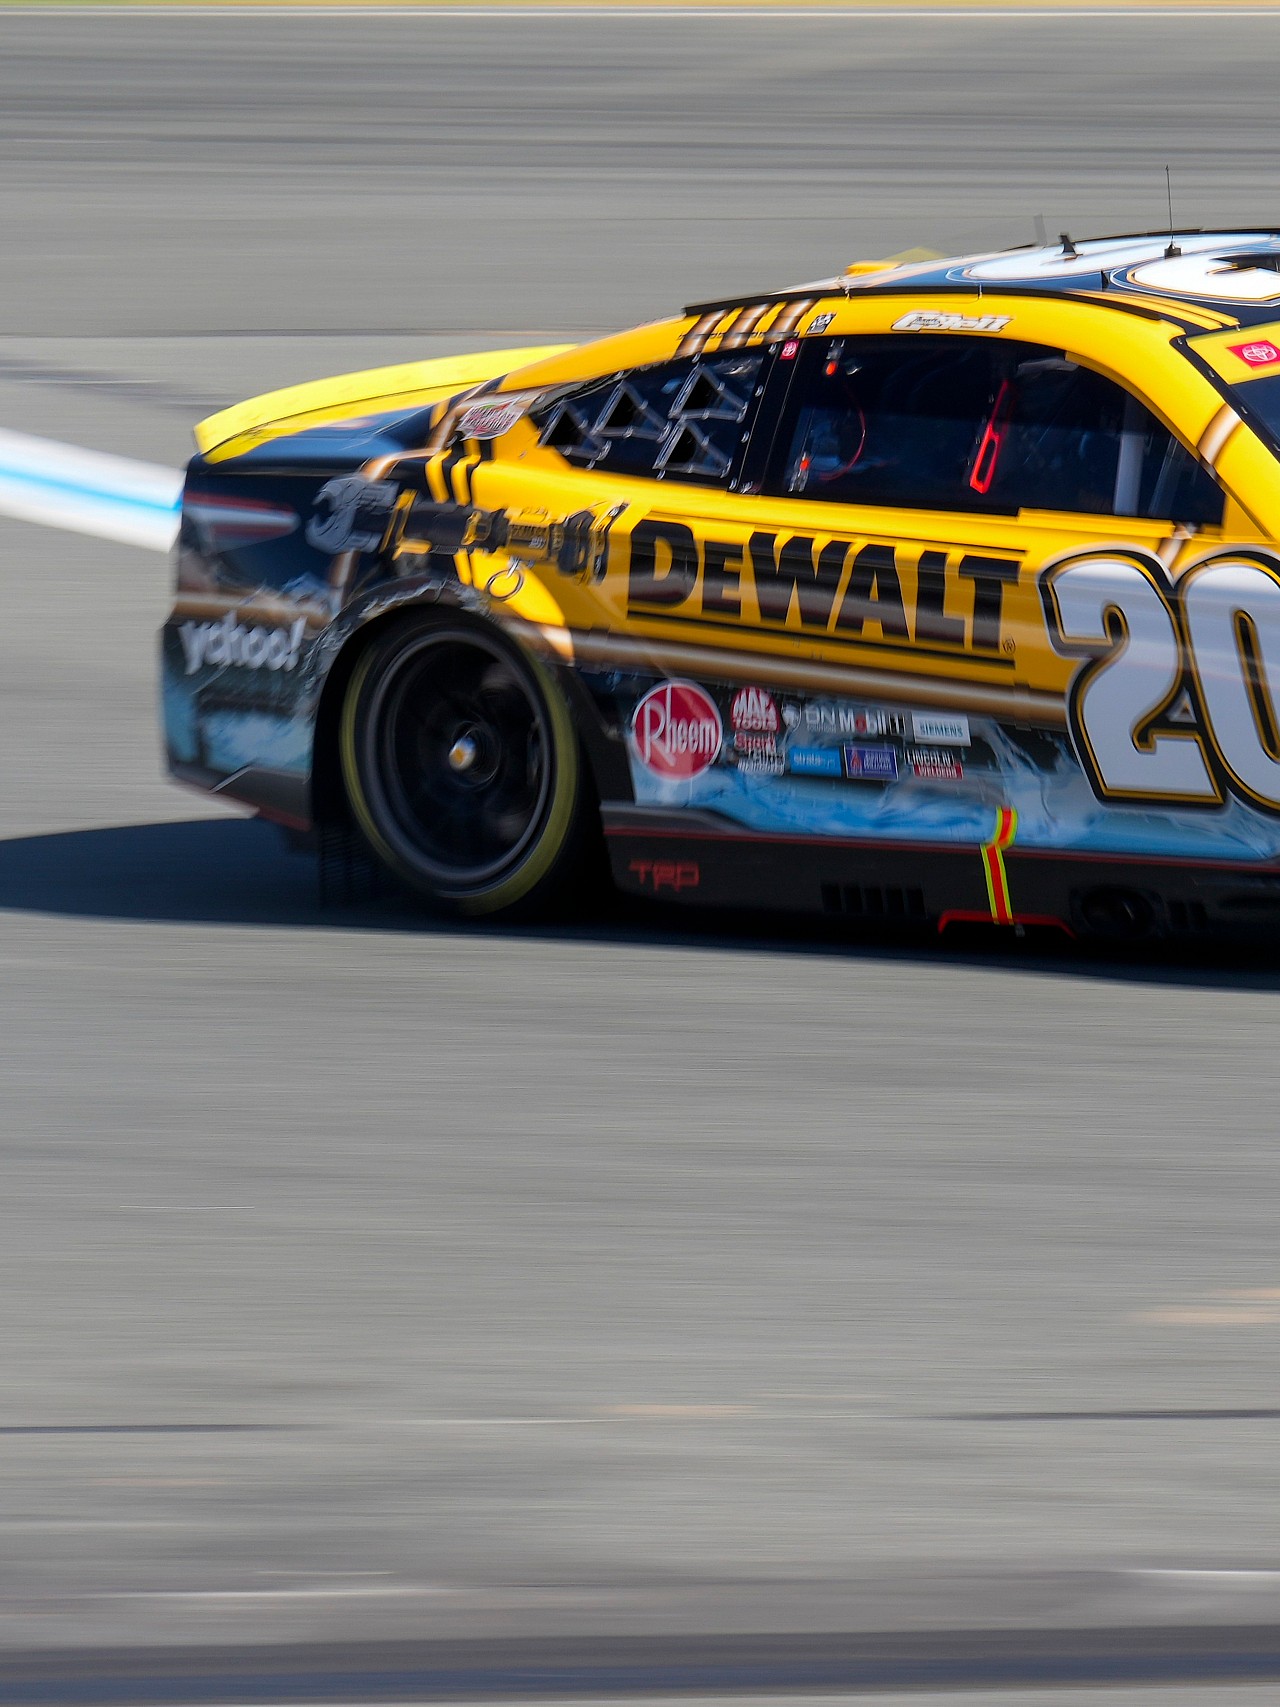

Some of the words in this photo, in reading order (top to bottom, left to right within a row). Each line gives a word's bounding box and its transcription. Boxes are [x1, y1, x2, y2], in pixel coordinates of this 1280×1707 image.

[627, 519, 1021, 653] DEWALT
[643, 684, 717, 768] Rheem
[838, 707, 887, 736] Mobil
